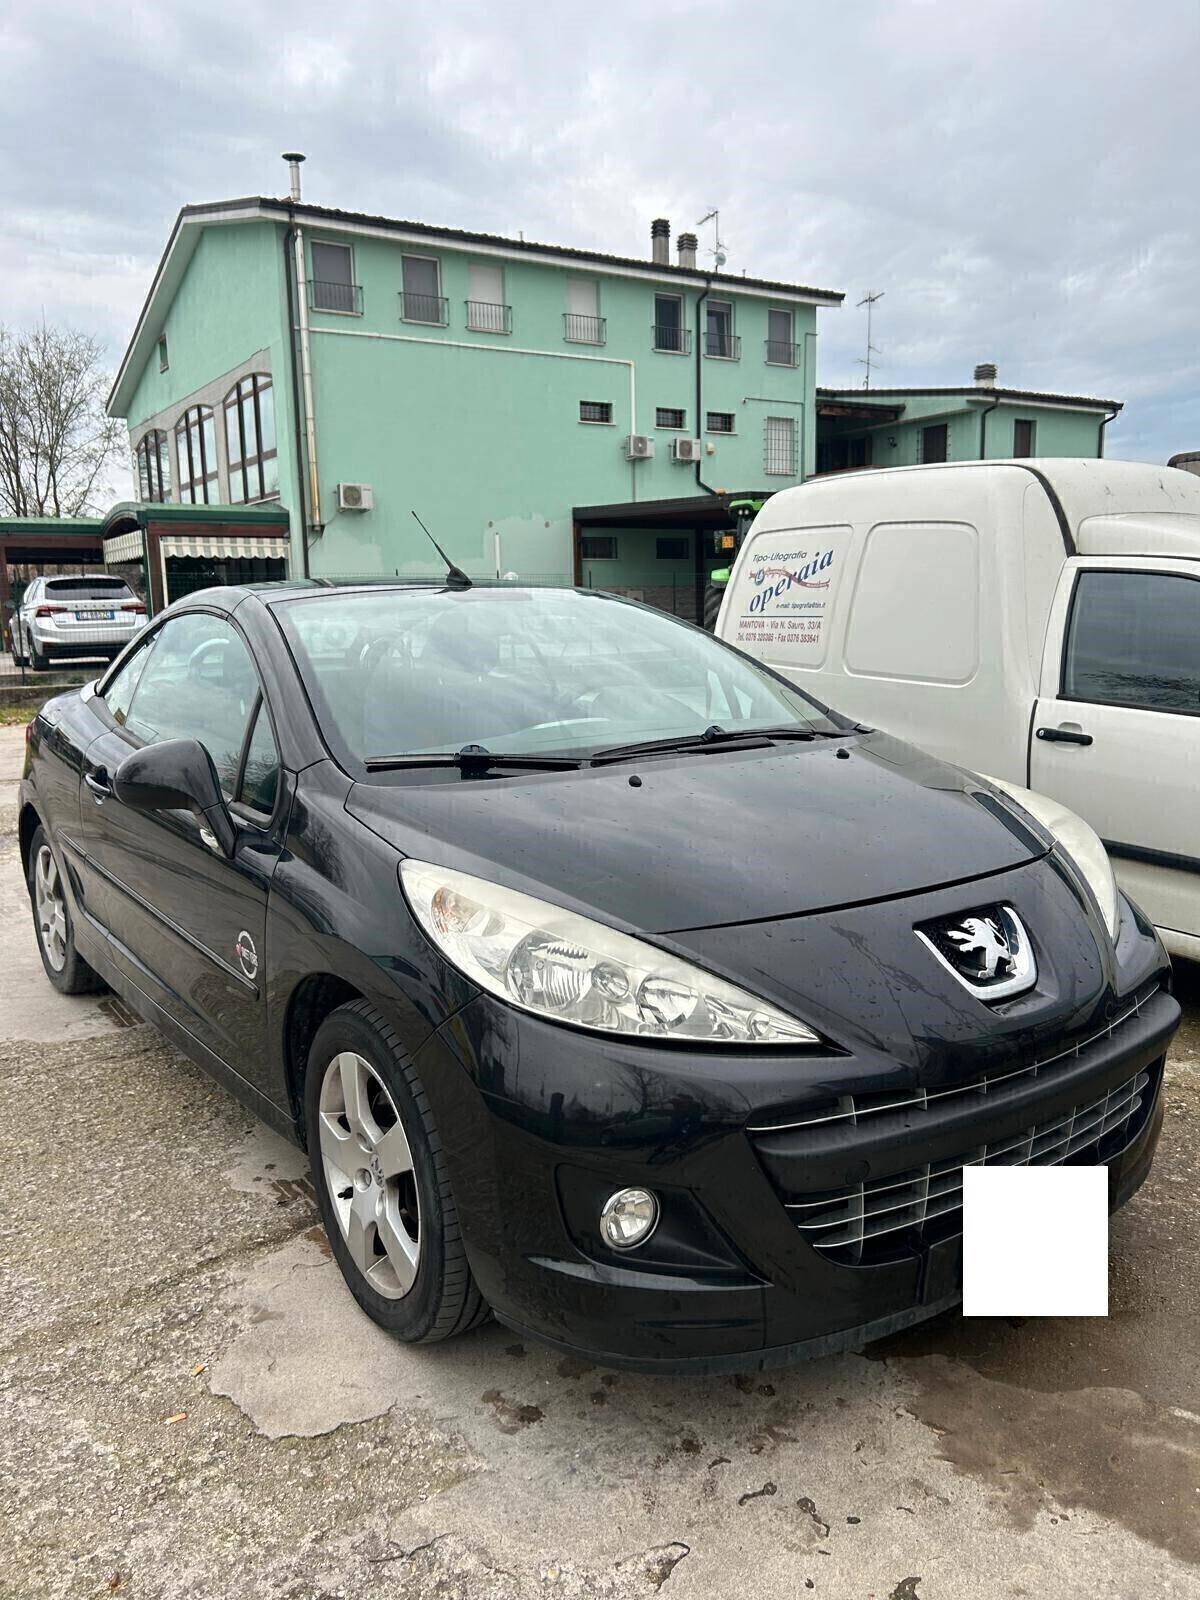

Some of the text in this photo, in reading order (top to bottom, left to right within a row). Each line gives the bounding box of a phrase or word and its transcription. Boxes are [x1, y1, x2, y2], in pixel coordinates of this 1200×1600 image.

[753, 551, 807, 562] Tipo-Litografia
[749, 550, 833, 613] operaia
[739, 621, 765, 629] MANTOVA
[770, 621, 779, 629] Via
[780, 621, 786, 629] N.
[787, 621, 806, 631] Sauro,
[807, 621, 821, 630] 33/A
[777, 634, 787, 642] Fax
